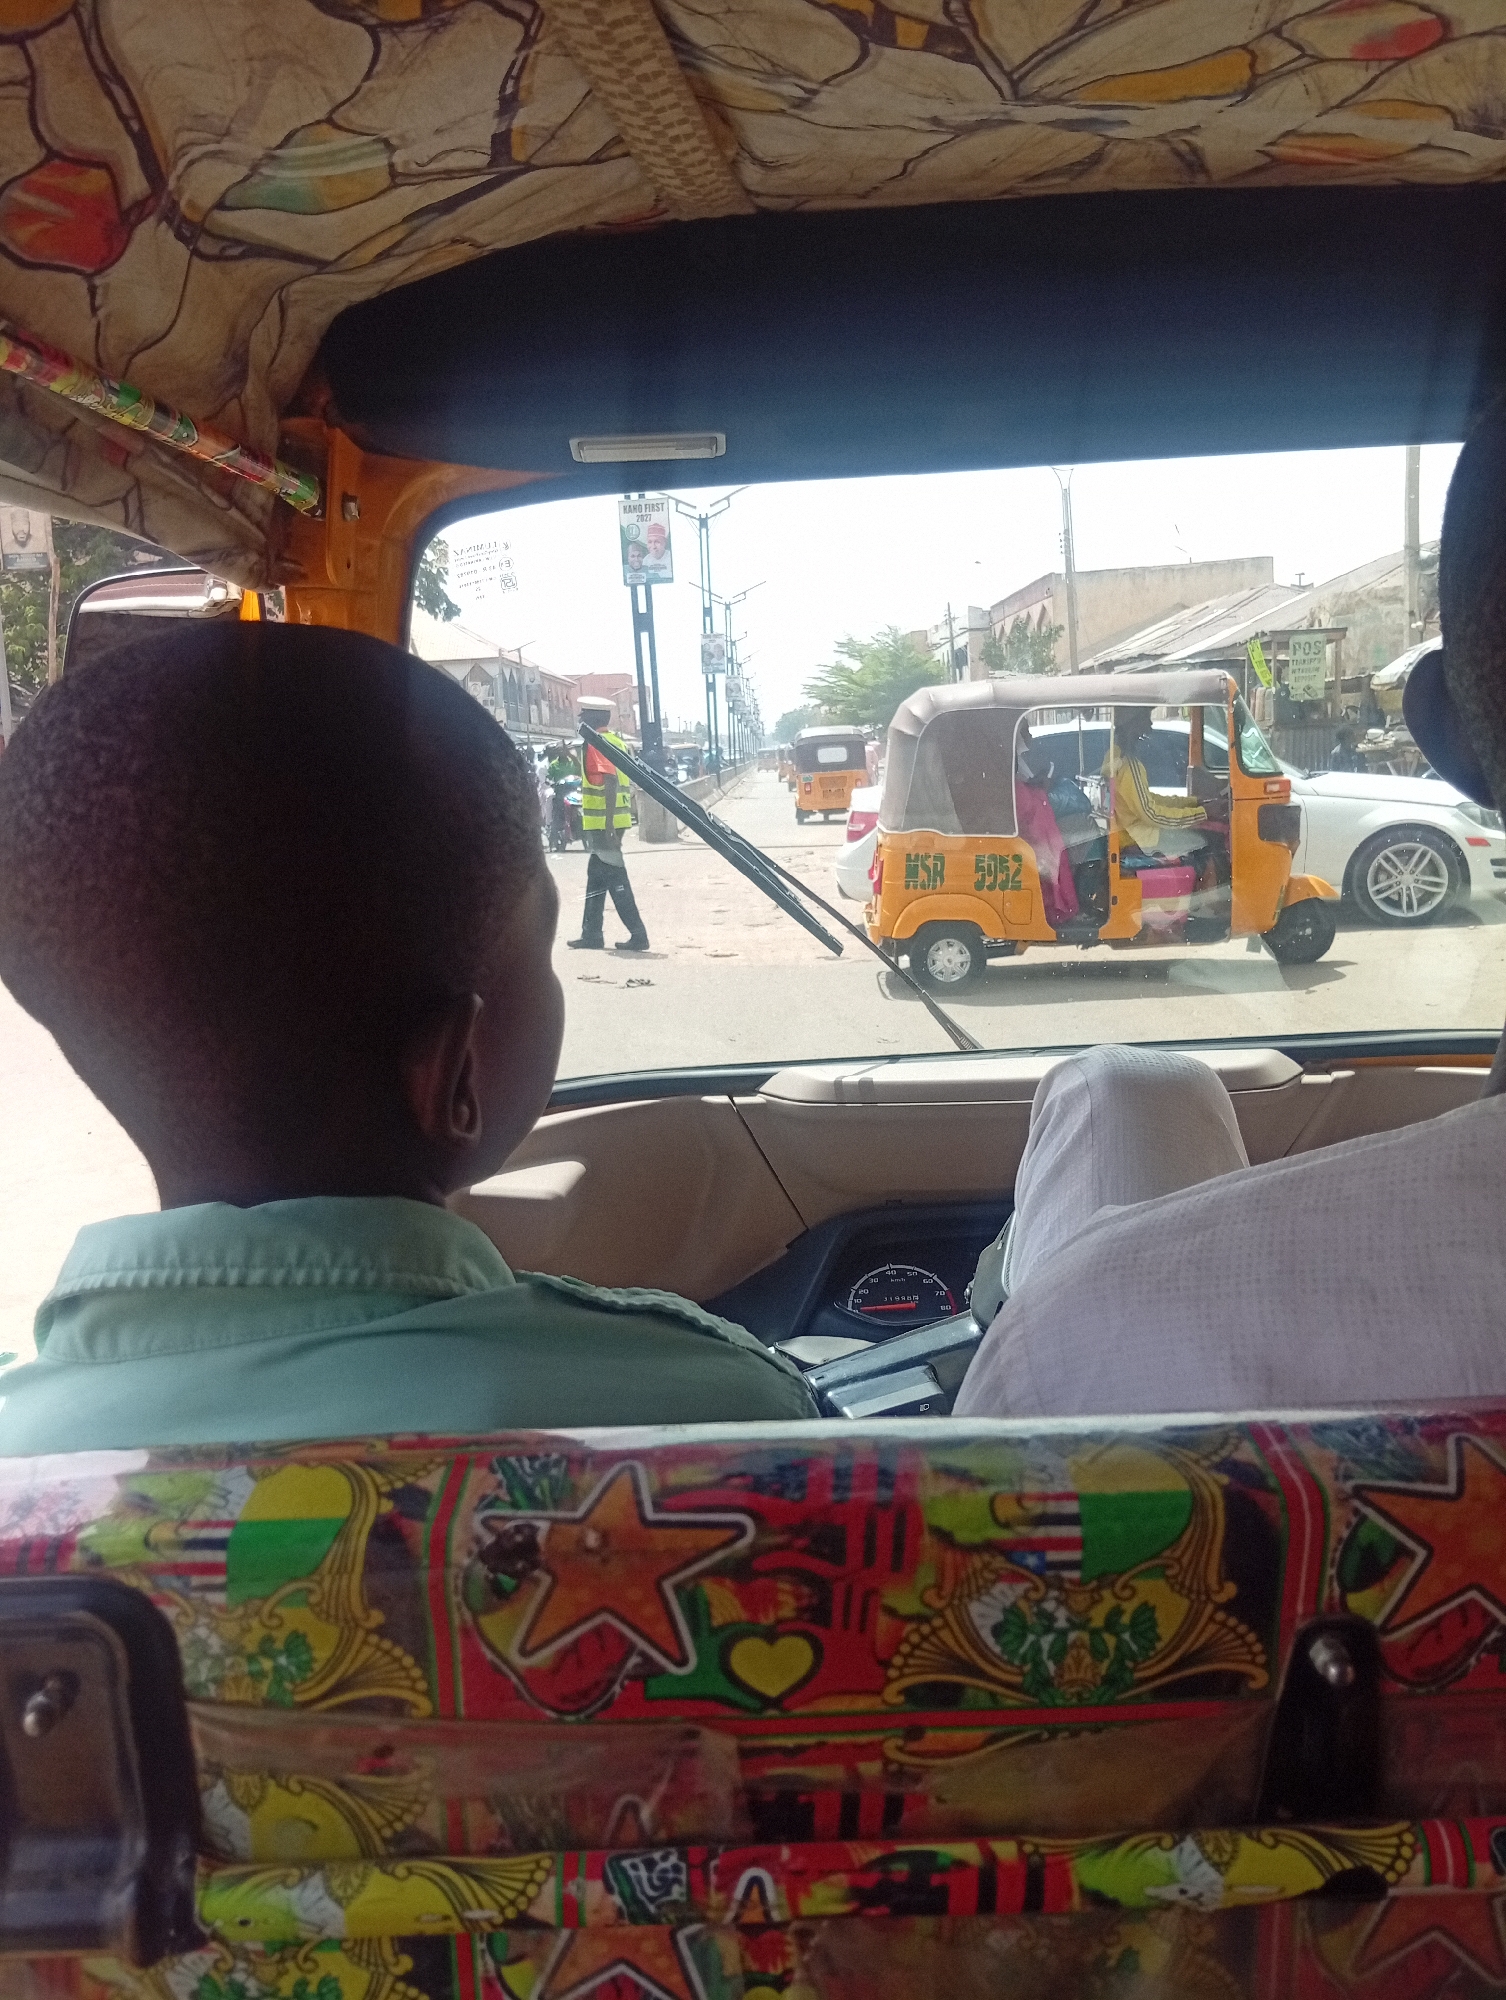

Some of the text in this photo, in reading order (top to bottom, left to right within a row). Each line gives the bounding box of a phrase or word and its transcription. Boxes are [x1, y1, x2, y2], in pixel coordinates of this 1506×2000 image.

[644, 502, 665, 513] FIRST
[636, 513, 652, 522] 2027
[1293, 640, 1322, 656] POS
[974, 853, 1022, 891] 5952
